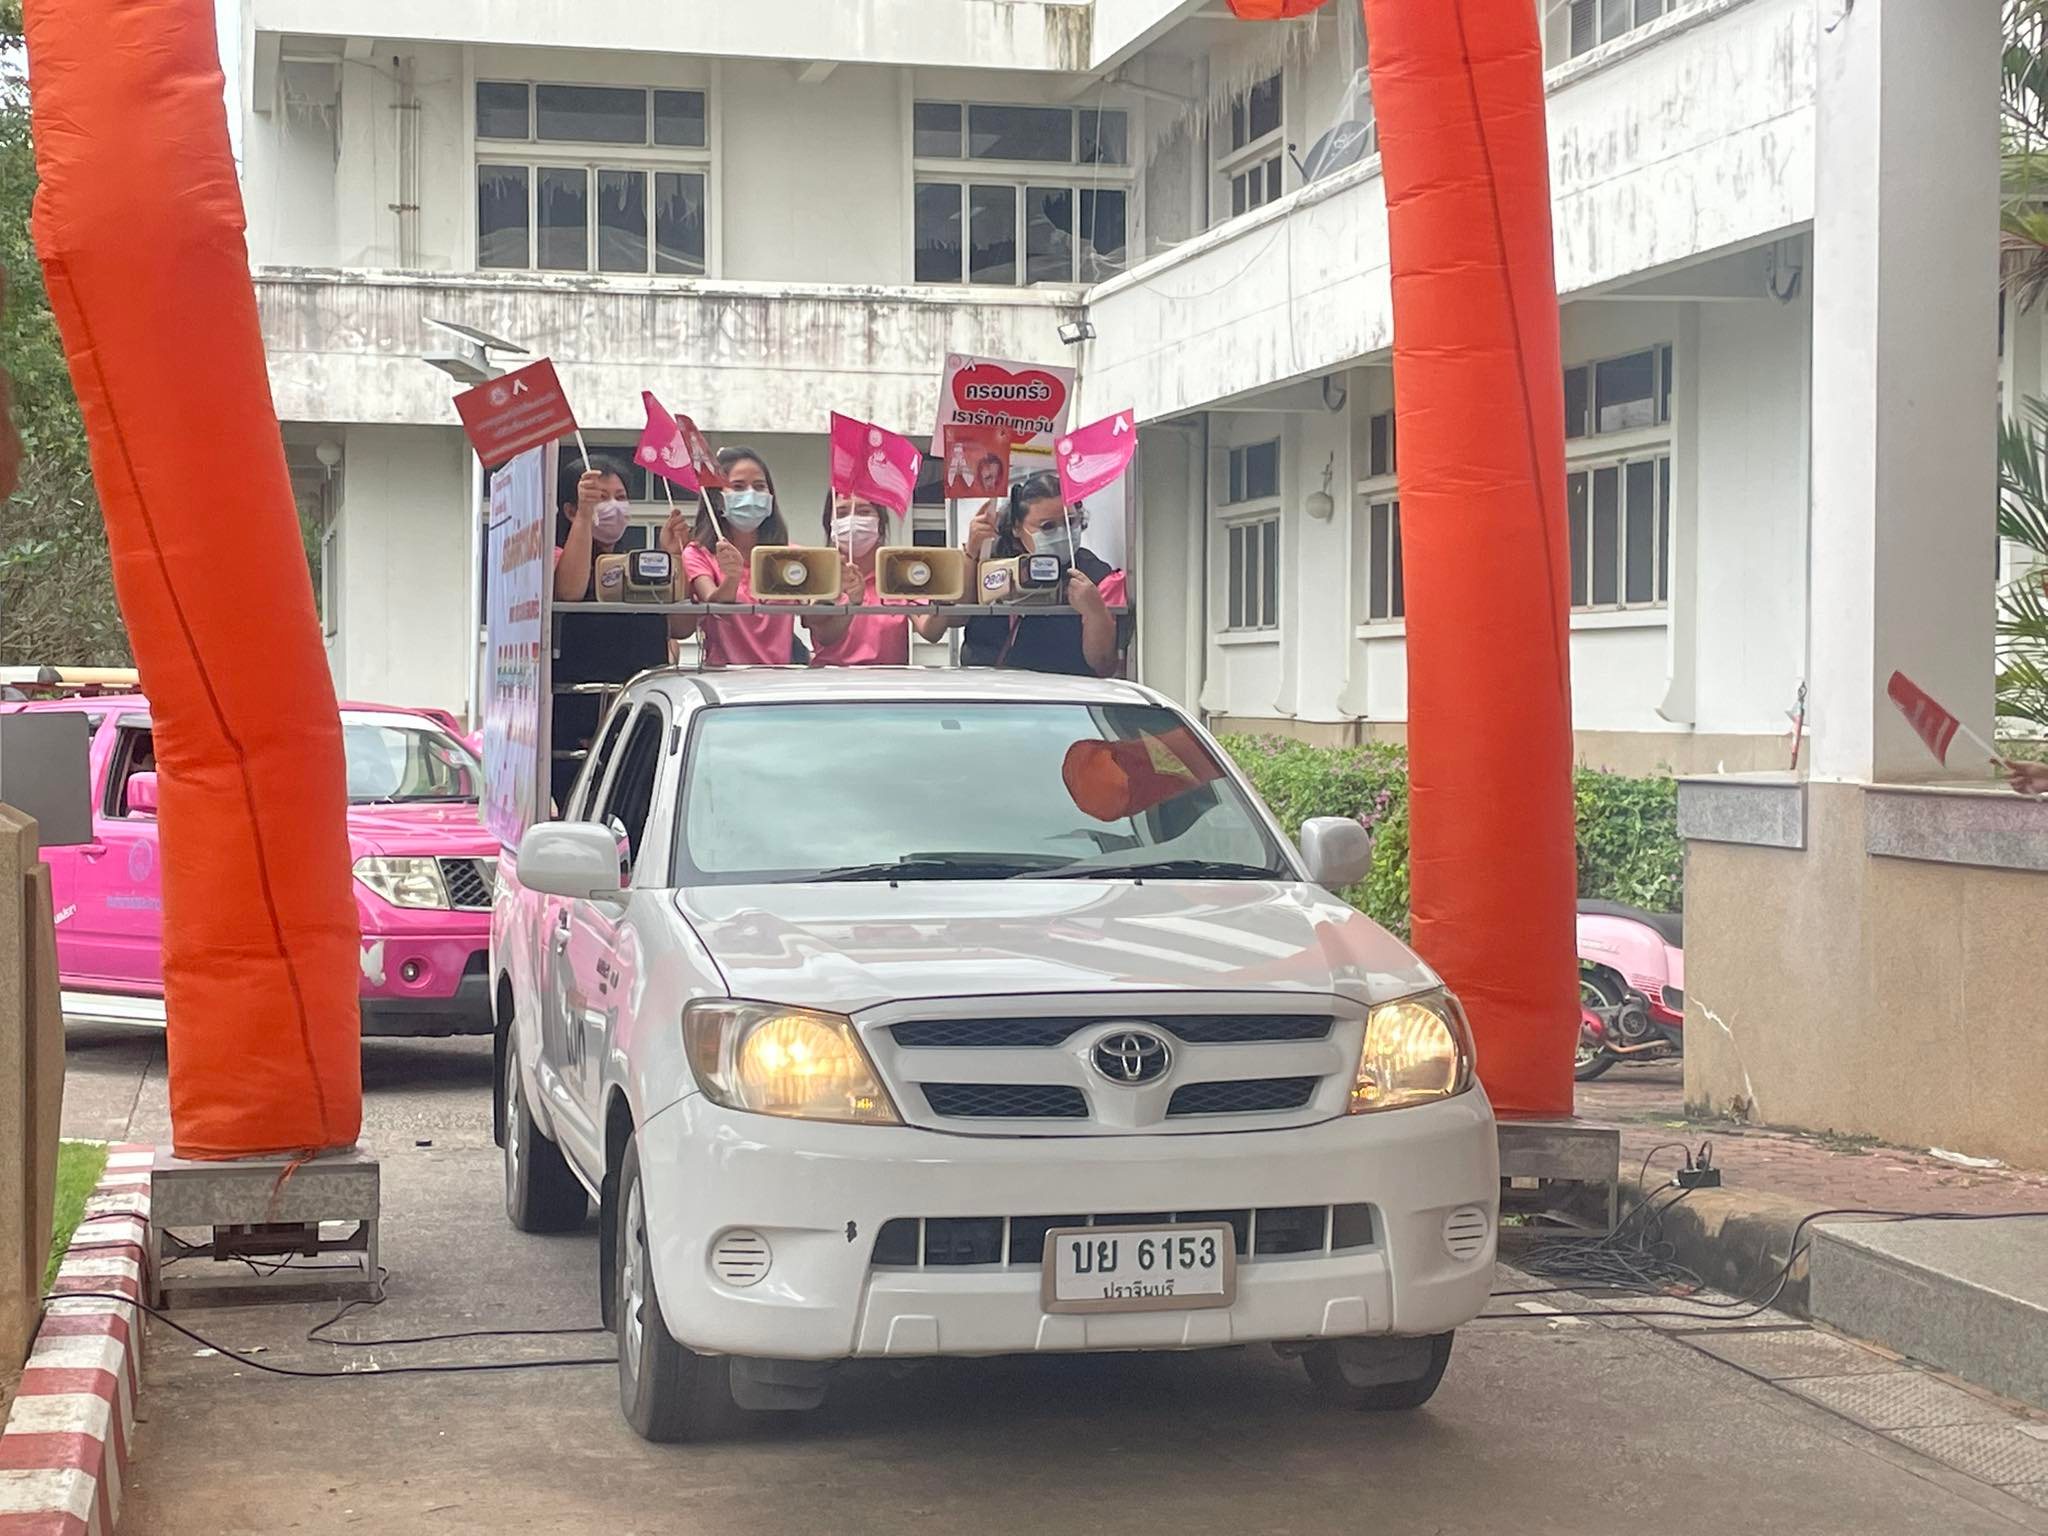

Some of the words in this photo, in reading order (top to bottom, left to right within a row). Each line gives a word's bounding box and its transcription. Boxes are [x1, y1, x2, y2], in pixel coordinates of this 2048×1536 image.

[966, 381, 1050, 399] ครอบครัว
[952, 410, 1054, 434] เรารักกันทุกวัน
[1072, 1240, 1118, 1273] บย
[1138, 1236, 1216, 1271] 6153
[1104, 1279, 1174, 1298] ปราจีนบรี
